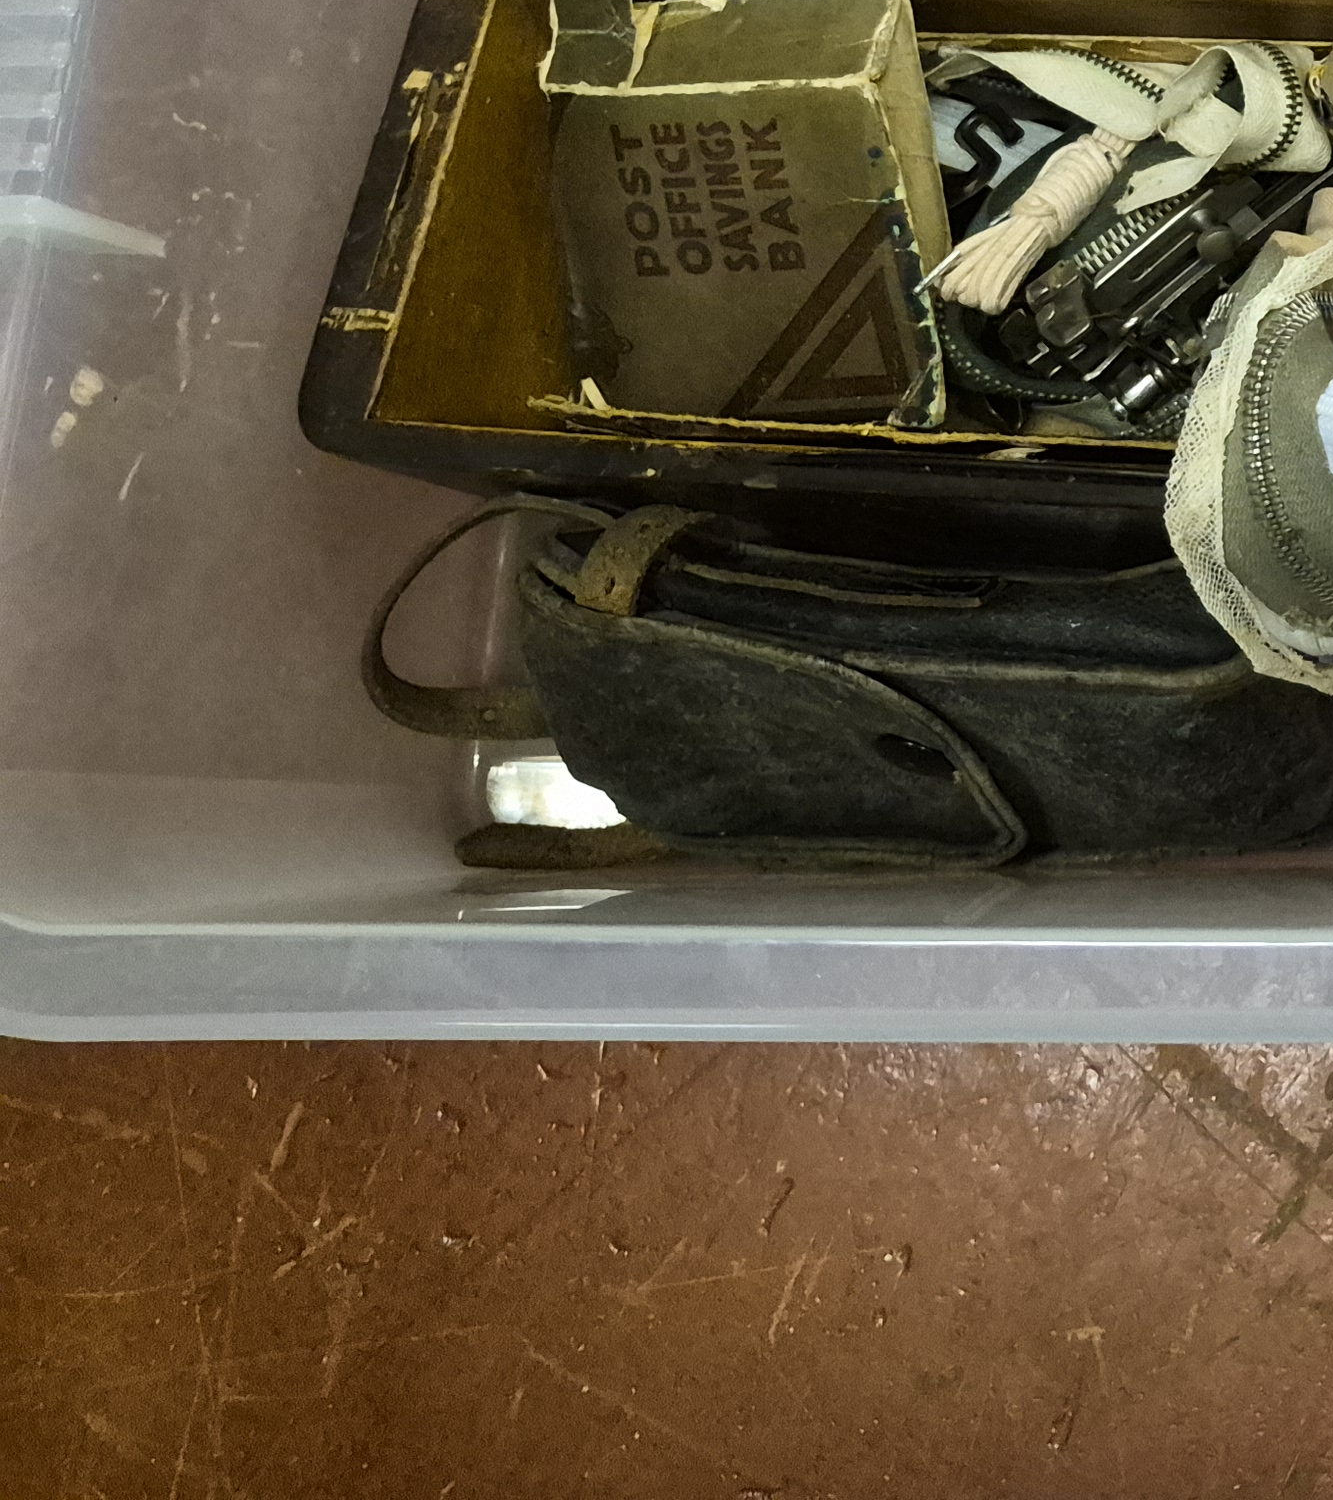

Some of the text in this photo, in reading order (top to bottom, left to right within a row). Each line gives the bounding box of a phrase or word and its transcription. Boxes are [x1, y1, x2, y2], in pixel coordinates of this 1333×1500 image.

[610, 124, 671, 277] POST
[650, 122, 713, 275] OFFICE
[696, 120, 760, 272] SAVINGS
[740, 117, 806, 272] BANK
